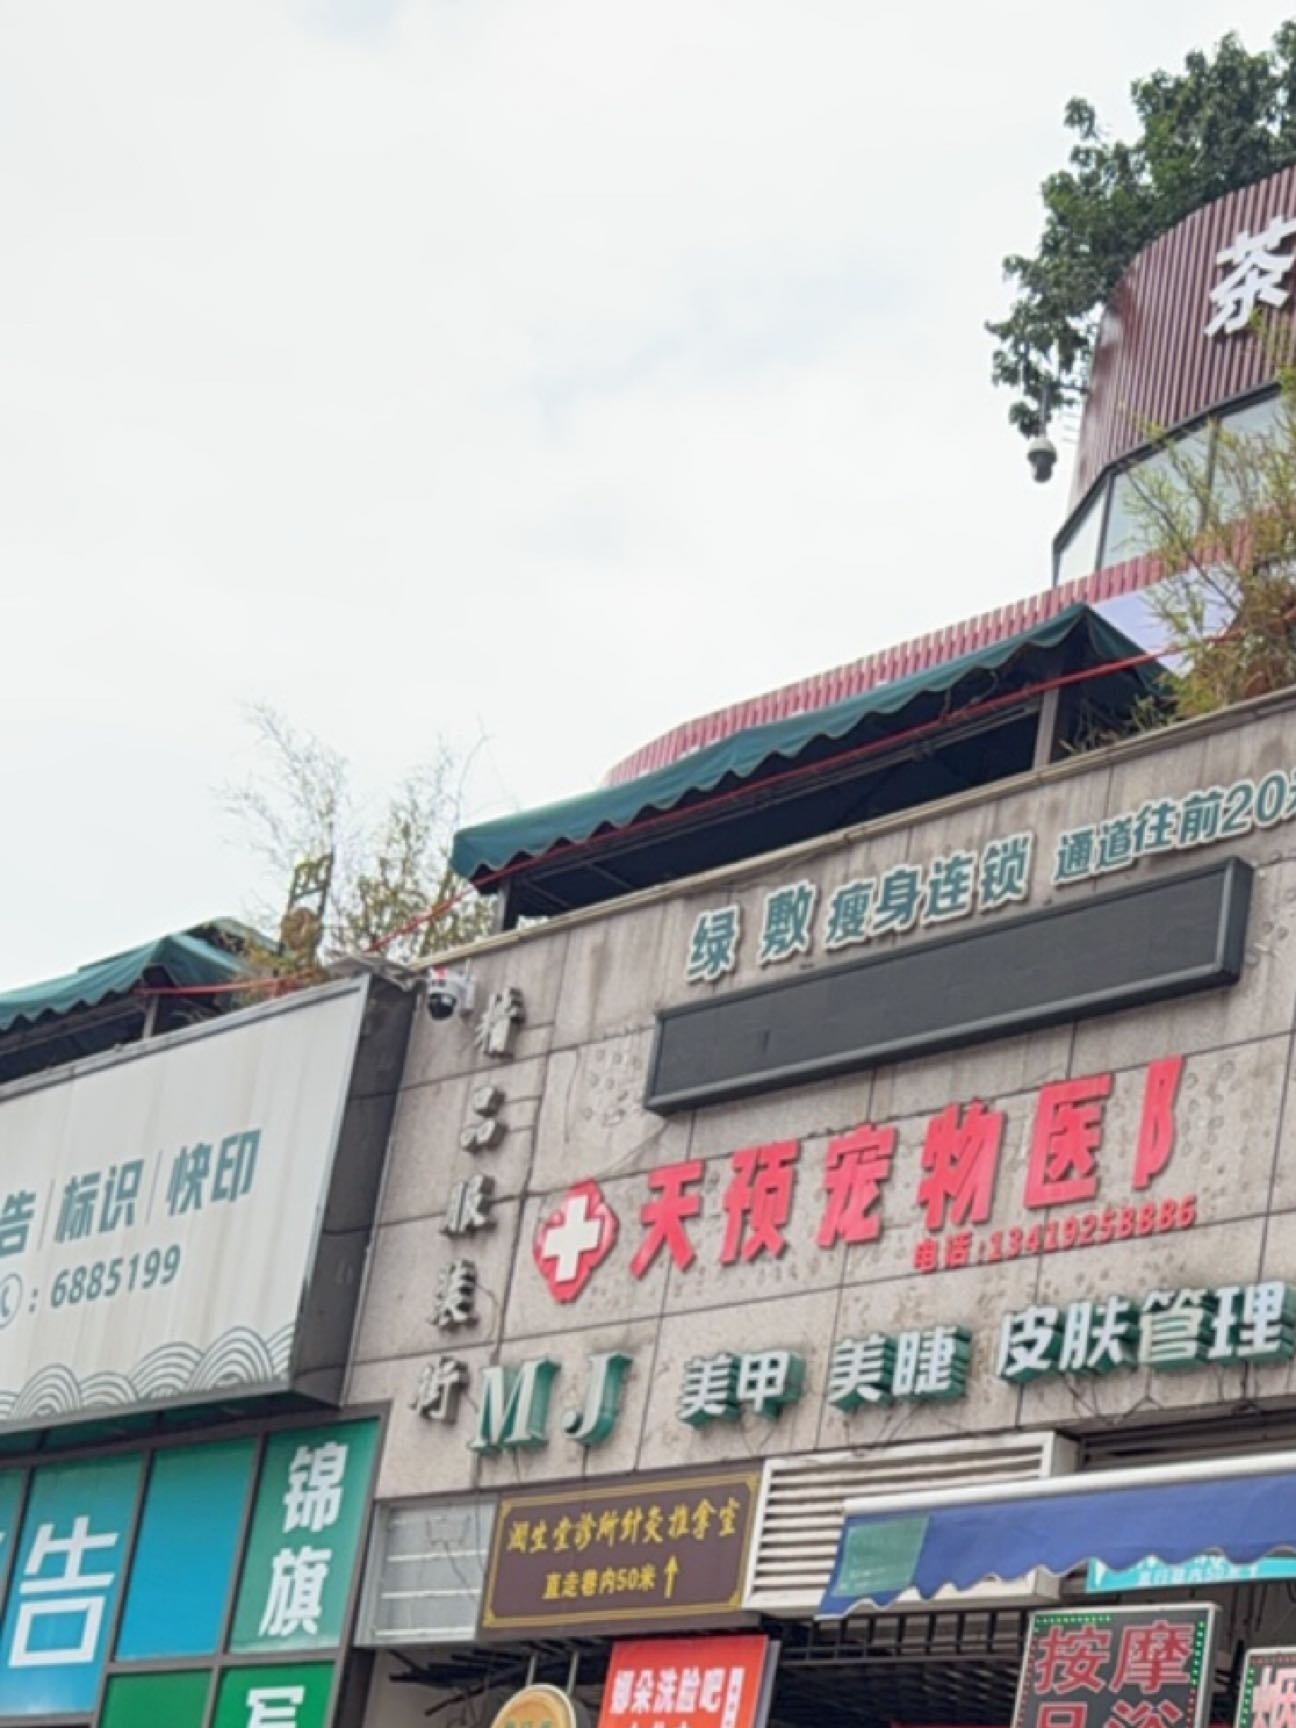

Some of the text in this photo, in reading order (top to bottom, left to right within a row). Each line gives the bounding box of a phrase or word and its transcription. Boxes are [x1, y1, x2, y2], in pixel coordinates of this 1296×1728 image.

[54, 1159, 146, 1245] 标识
[166, 1128, 264, 1218] 快印
[679, 1348, 803, 1428] 美甲
[826, 1322, 972, 1411] 美睫
[8, 1515, 120, 1670] 告
[258, 1441, 349, 1638] 锦旗
[1033, 1619, 1197, 1695] 按摩
